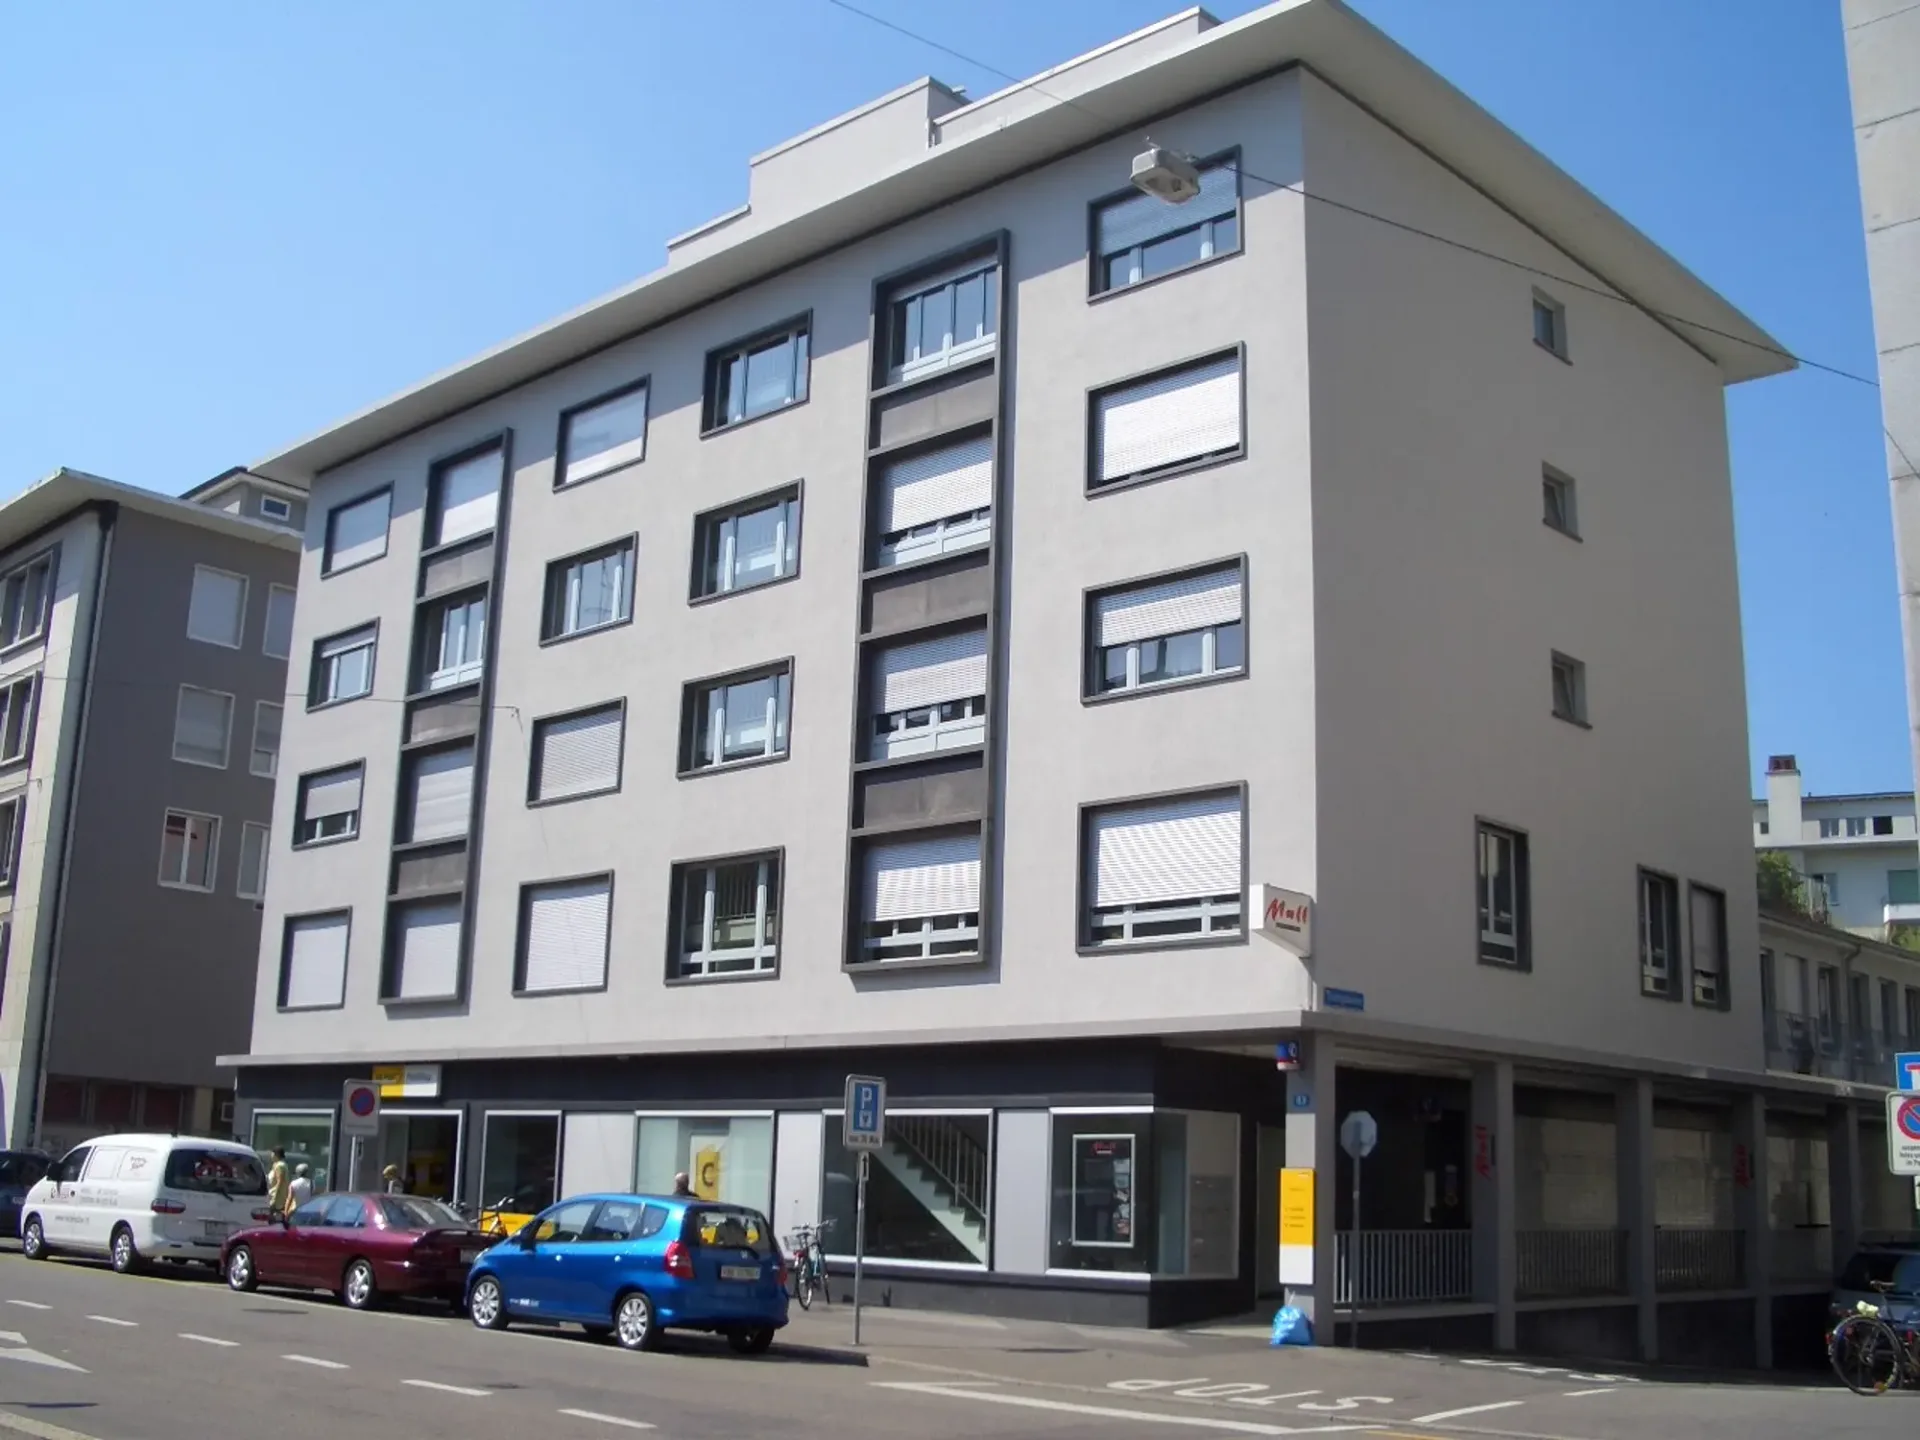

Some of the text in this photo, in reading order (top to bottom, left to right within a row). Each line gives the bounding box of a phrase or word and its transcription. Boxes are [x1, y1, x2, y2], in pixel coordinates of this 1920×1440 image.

[1265, 898, 1308, 924] Mall
[861, 1086, 873, 1109] P
[1106, 1377, 1394, 1411] STOP
